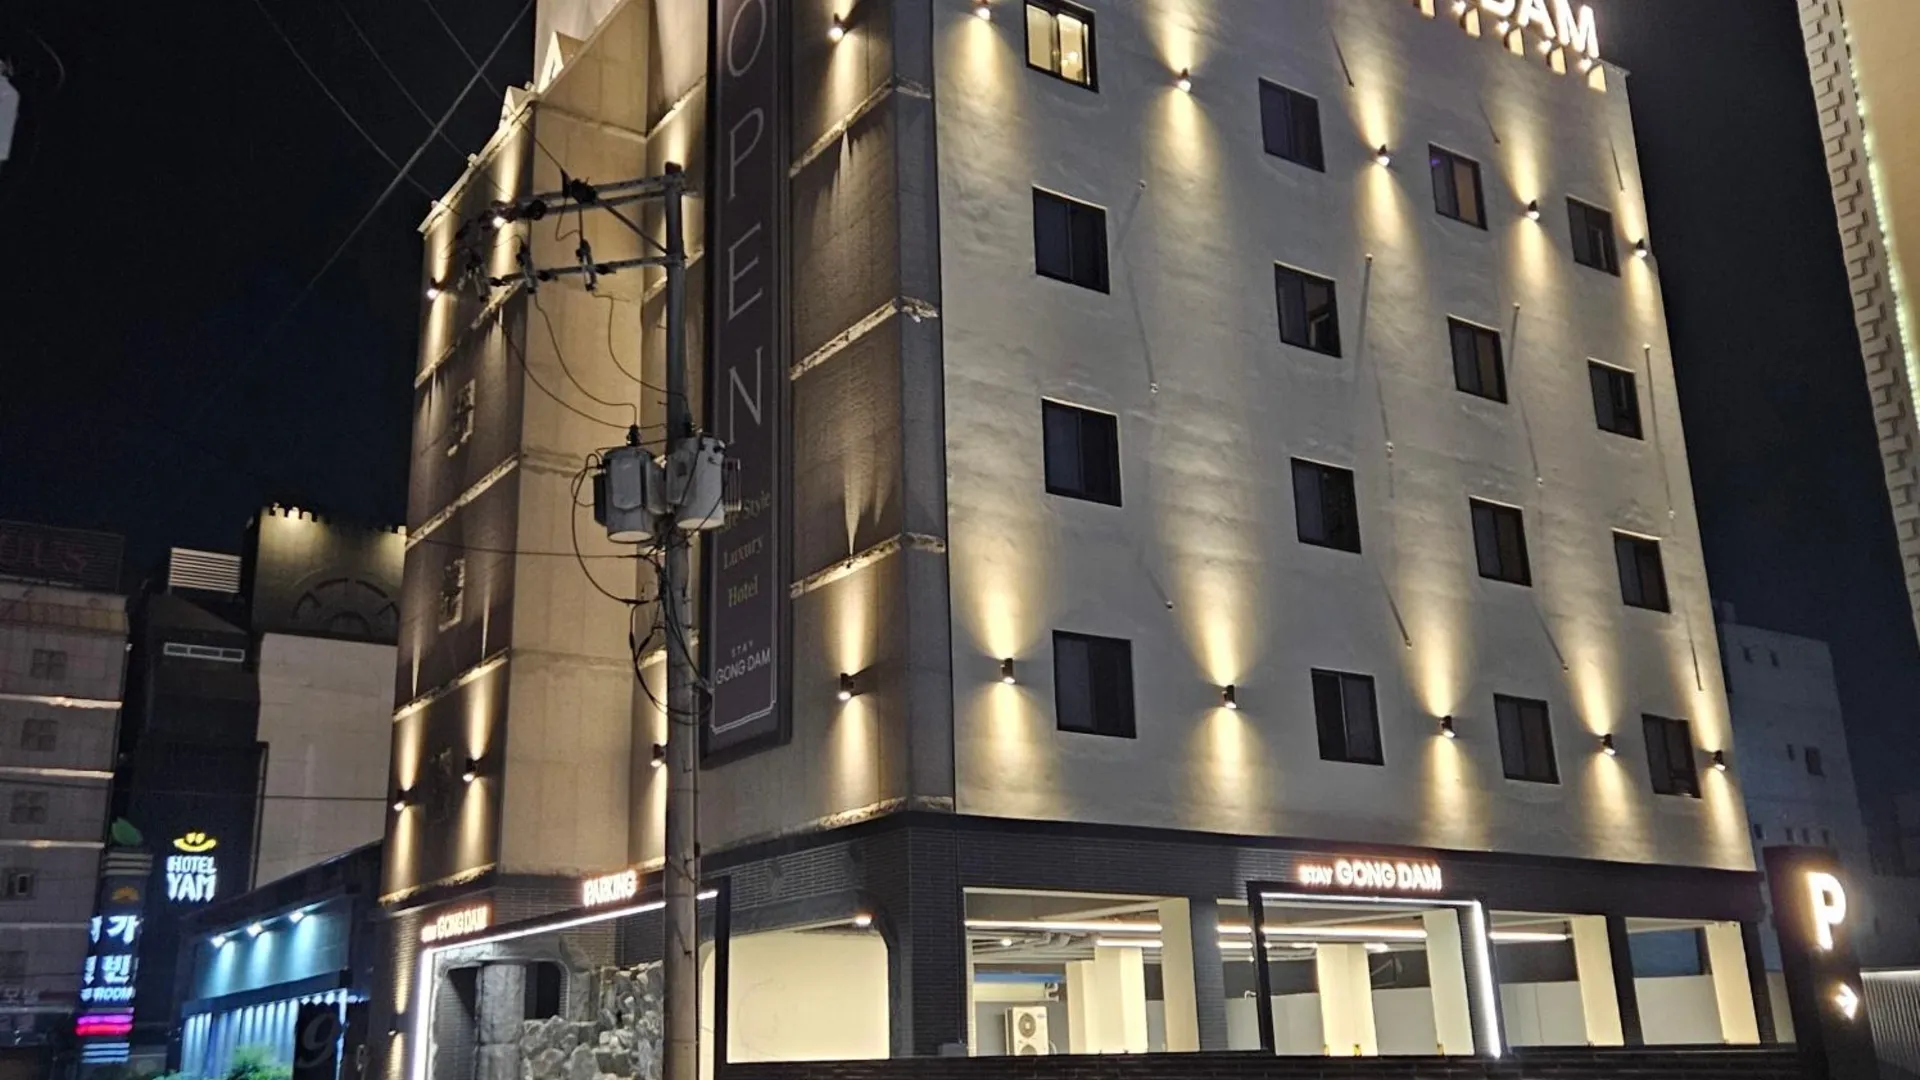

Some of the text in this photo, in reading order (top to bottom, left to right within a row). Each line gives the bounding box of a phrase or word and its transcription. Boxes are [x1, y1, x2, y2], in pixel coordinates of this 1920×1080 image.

[728, 0, 767, 445] OPEN
[724, 536, 764, 570] Luxury
[728, 575, 758, 608] Hotel
[716, 647, 771, 685] GONG DAM
[167, 855, 217, 872] HOTEL
[1335, 858, 1396, 888] GONG
[1396, 861, 1442, 892] DAM
[167, 872, 217, 903] YAM
[583, 869, 637, 907] PARKING
[1806, 871, 1846, 951] P
